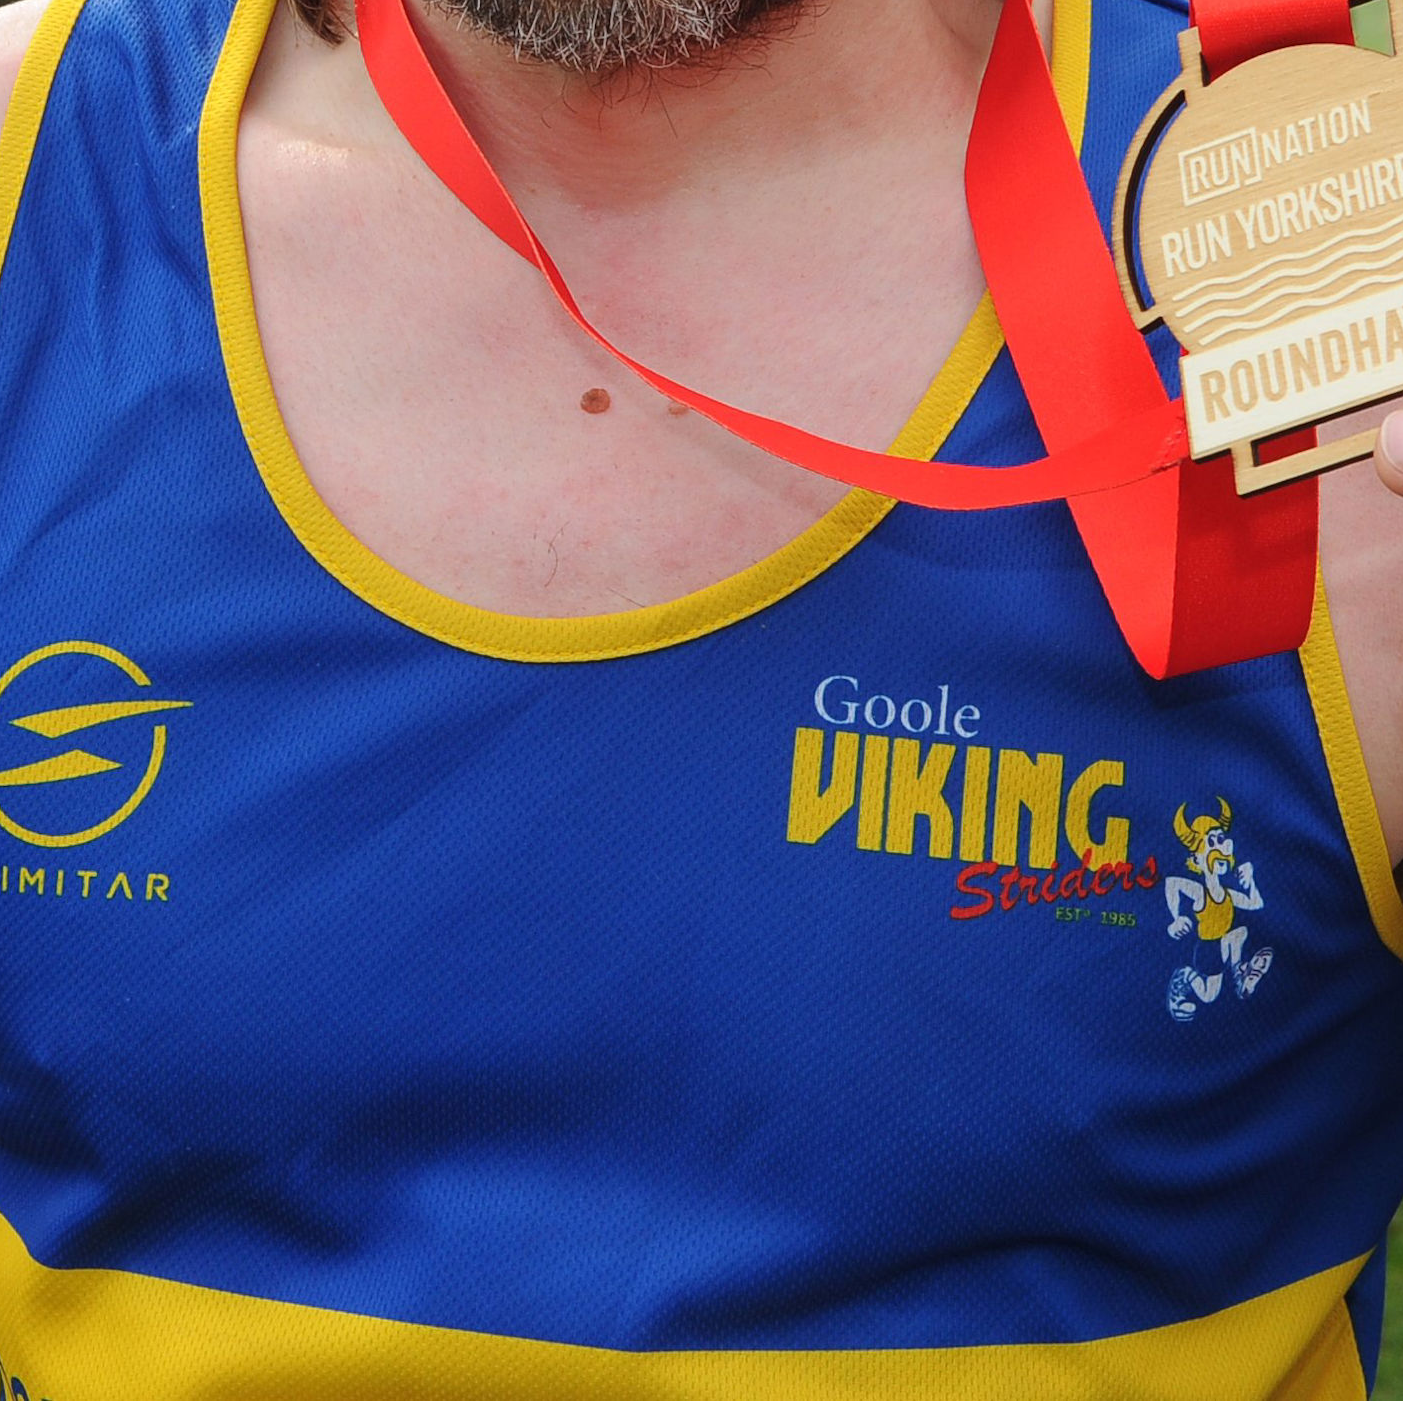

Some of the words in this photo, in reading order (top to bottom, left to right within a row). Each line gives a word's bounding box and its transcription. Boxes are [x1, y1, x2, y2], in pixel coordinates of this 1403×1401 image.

[1161, 215, 1233, 278] RUN
[814, 675, 982, 738] Goole
[787, 726, 1131, 872] VIKING
[950, 849, 1160, 919] Striders
[1100, 910, 1136, 927] 1985
